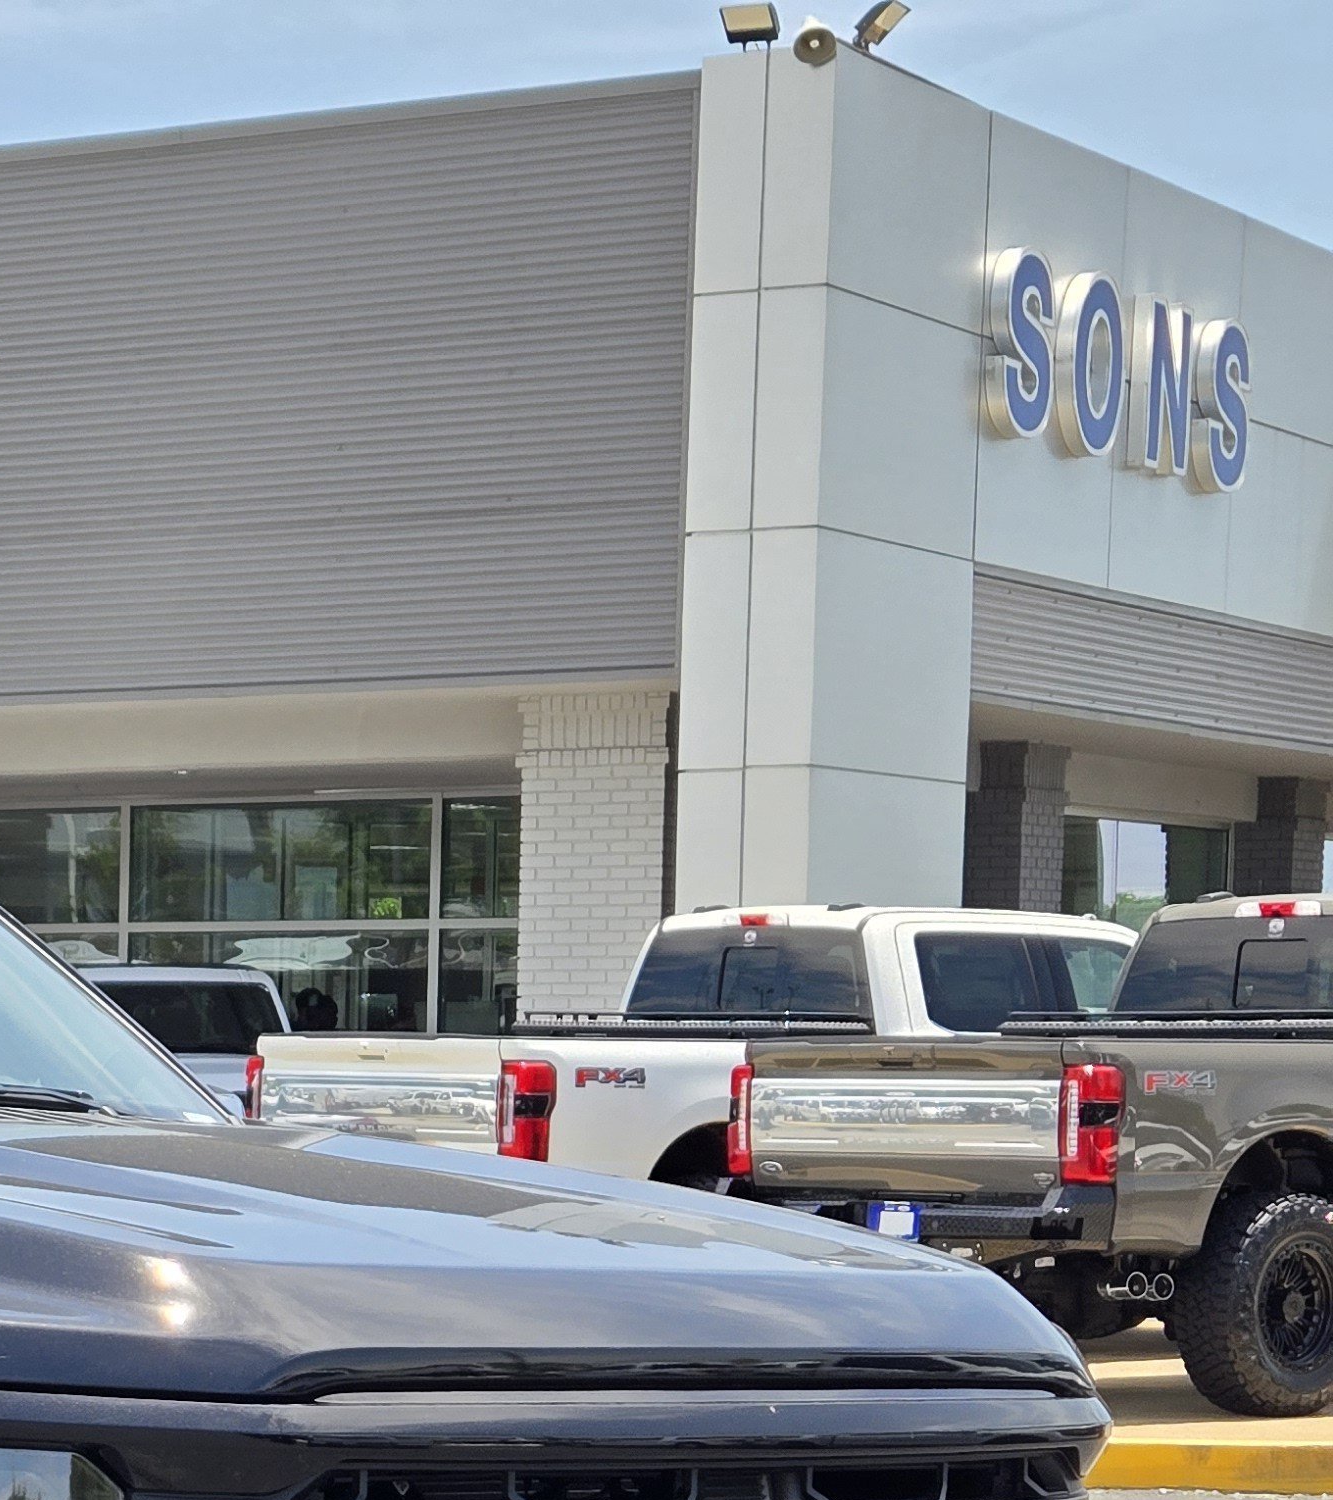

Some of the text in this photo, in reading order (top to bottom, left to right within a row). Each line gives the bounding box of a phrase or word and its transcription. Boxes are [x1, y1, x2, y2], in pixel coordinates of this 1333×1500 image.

[983, 246, 1252, 495] SONS
[575, 1066, 647, 1088] FX4
[1144, 1070, 1217, 1096] FX4
